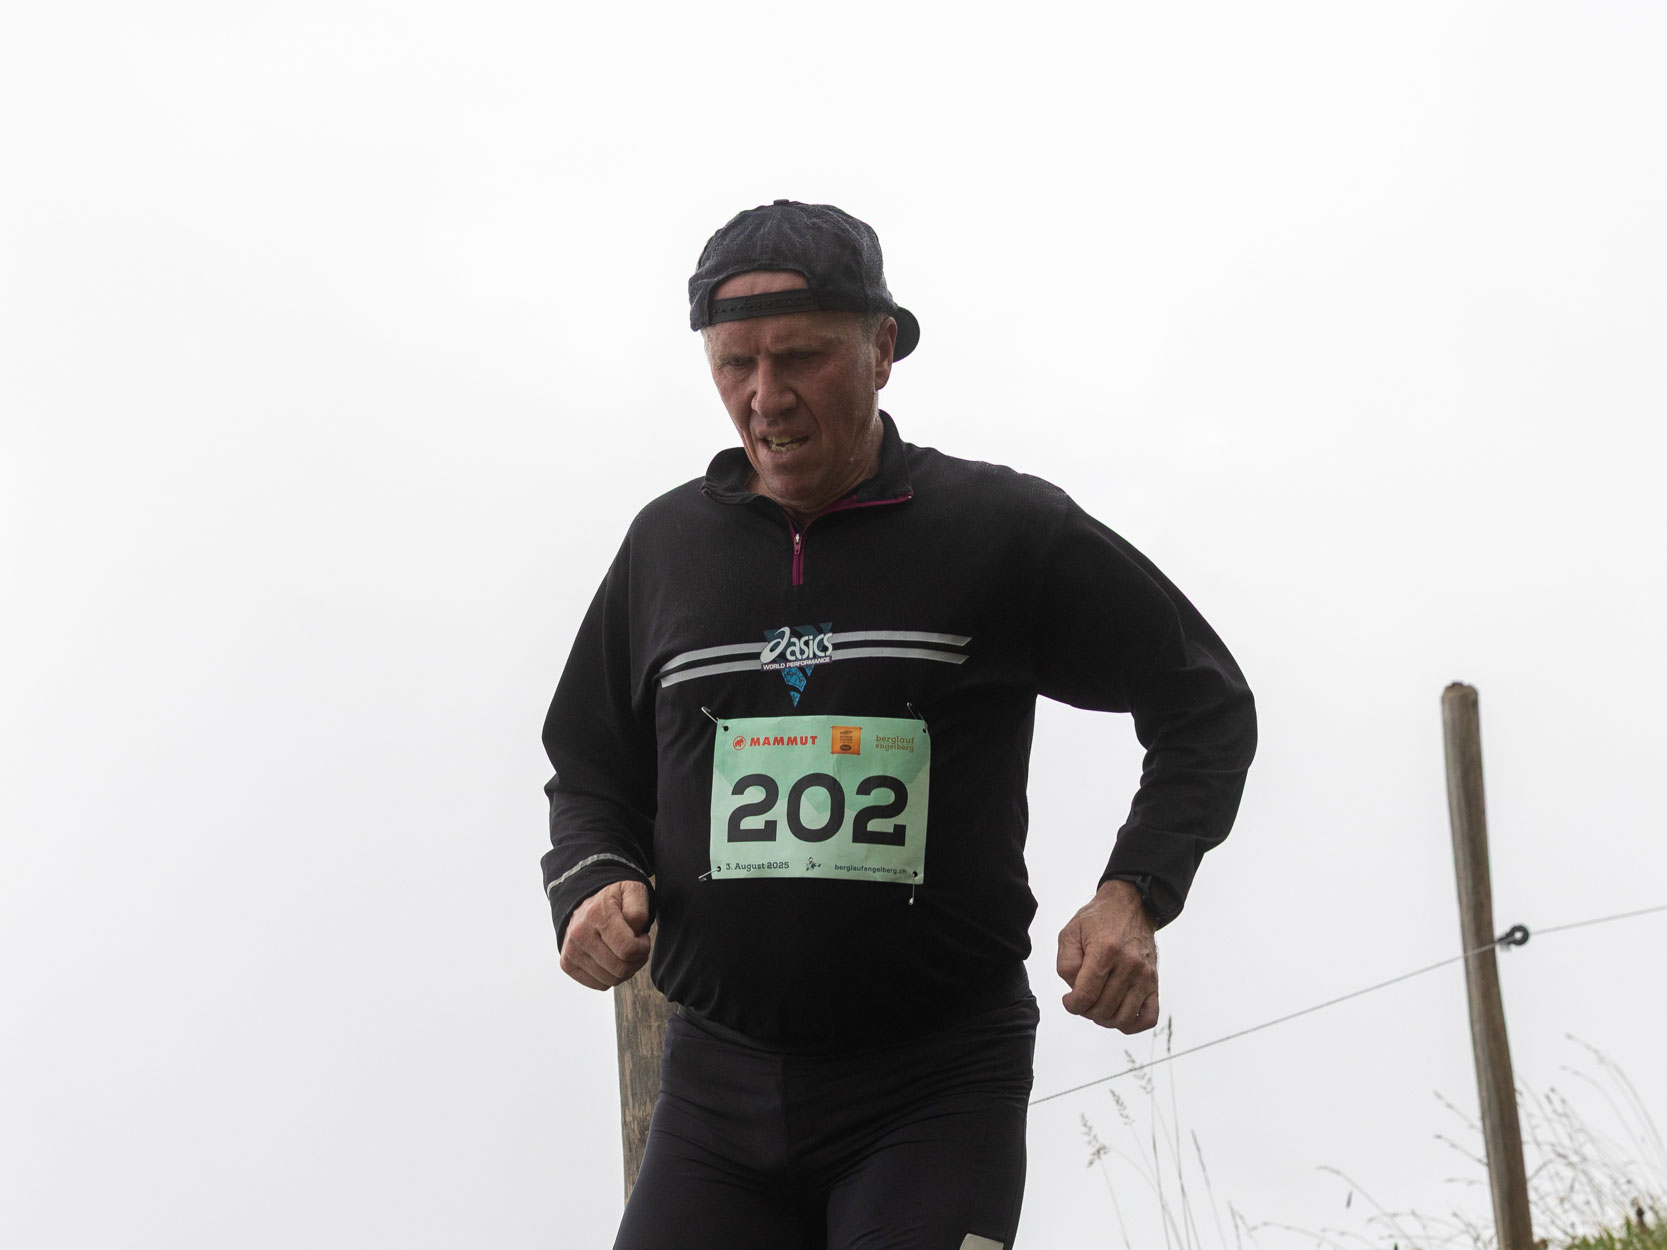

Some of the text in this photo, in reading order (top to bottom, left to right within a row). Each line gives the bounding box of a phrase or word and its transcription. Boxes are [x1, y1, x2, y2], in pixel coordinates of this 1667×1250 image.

[762, 656, 831, 671] WORLD PERFORMANCE
[749, 735, 818, 747] MAMMUT
[875, 734, 915, 745] berglauf
[875, 743, 915, 753] engelberg
[727, 772, 909, 847] 202
[725, 861, 790, 872] 3. August 2025
[834, 863, 907, 875] berglaufengelberg.ch
